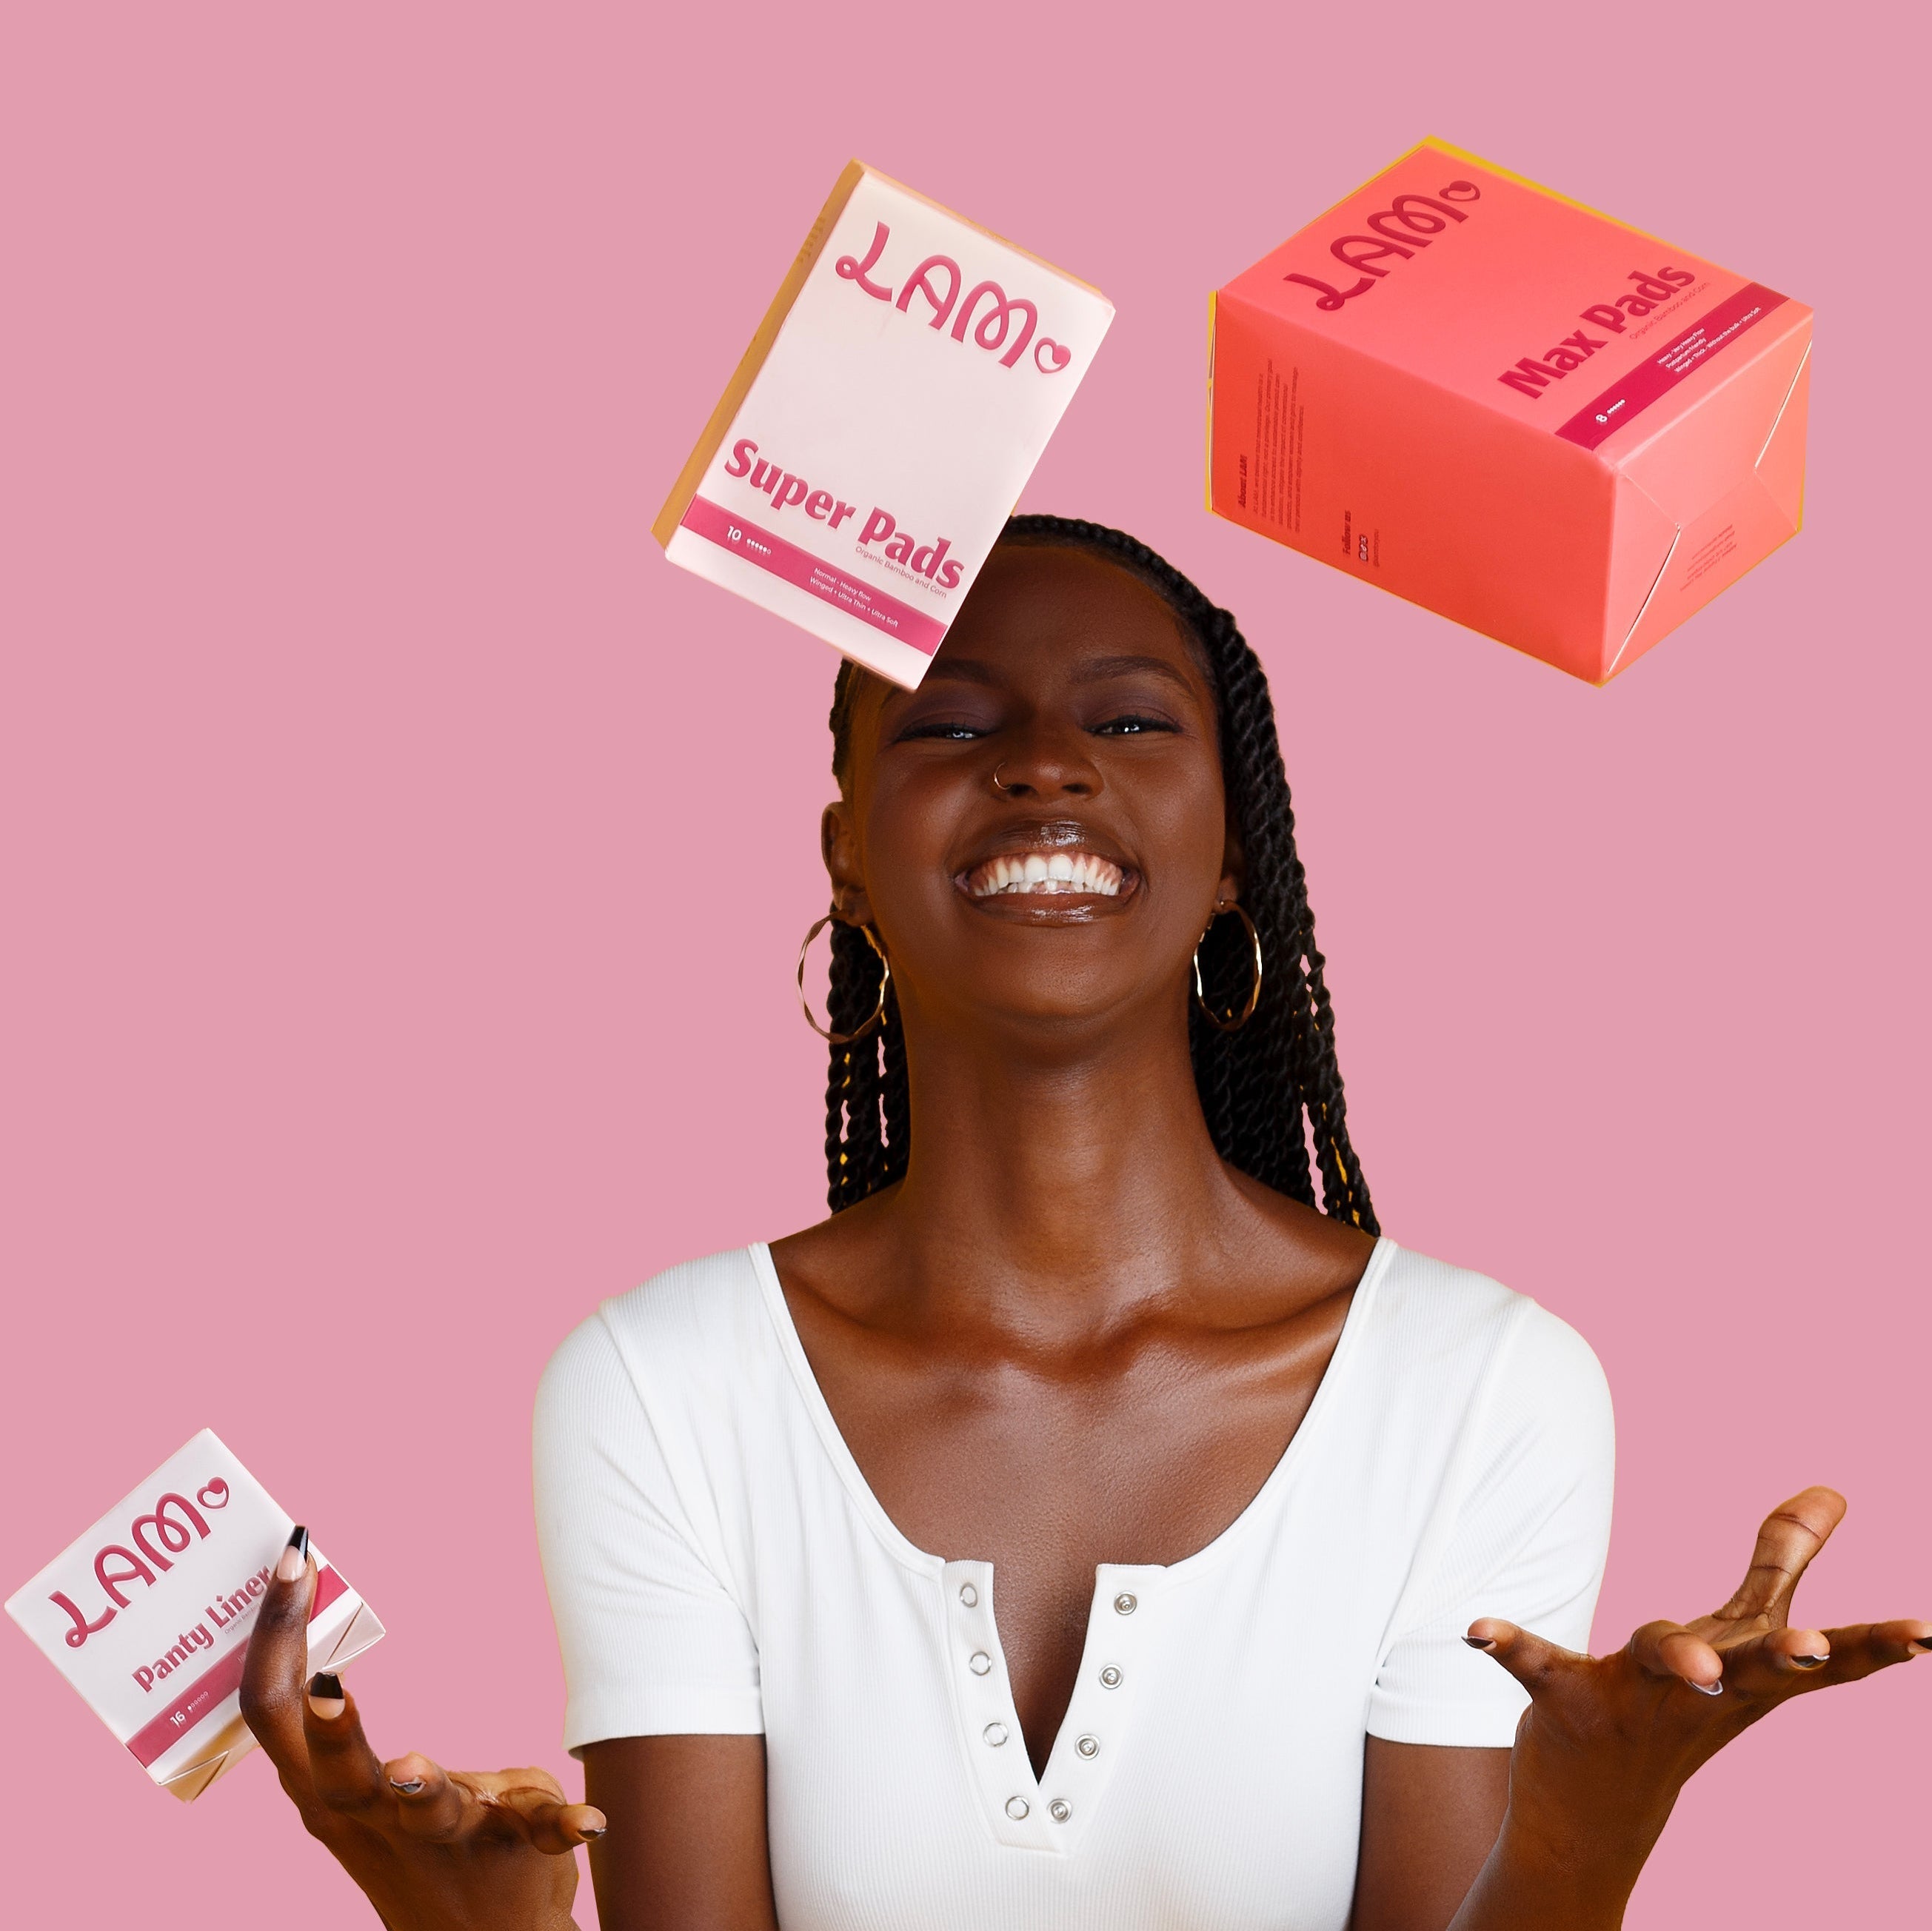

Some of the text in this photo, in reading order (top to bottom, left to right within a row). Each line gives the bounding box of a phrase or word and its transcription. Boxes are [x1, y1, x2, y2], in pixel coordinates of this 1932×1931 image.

[1283, 194, 1468, 312] LAM
[835, 221, 1037, 368] LAM
[1497, 263, 1695, 399] Max Pads
[1595, 413, 1608, 423] 8
[724, 438, 964, 589] Super Pads
[726, 524, 743, 541] 10
[1342, 510, 1351, 555] Follow us
[815, 568, 837, 584] Normal
[840, 580, 858, 595] Heavy
[855, 546, 947, 599] Organic Bamboo and Corn
[810, 577, 899, 628] Winged Ultra Thin Ultra Soft
[48, 1492, 212, 1648] LAM
[224, 1619, 245, 1634] Organic
[131, 1622, 215, 1693] Panty
[169, 1710, 186, 1727] 16
